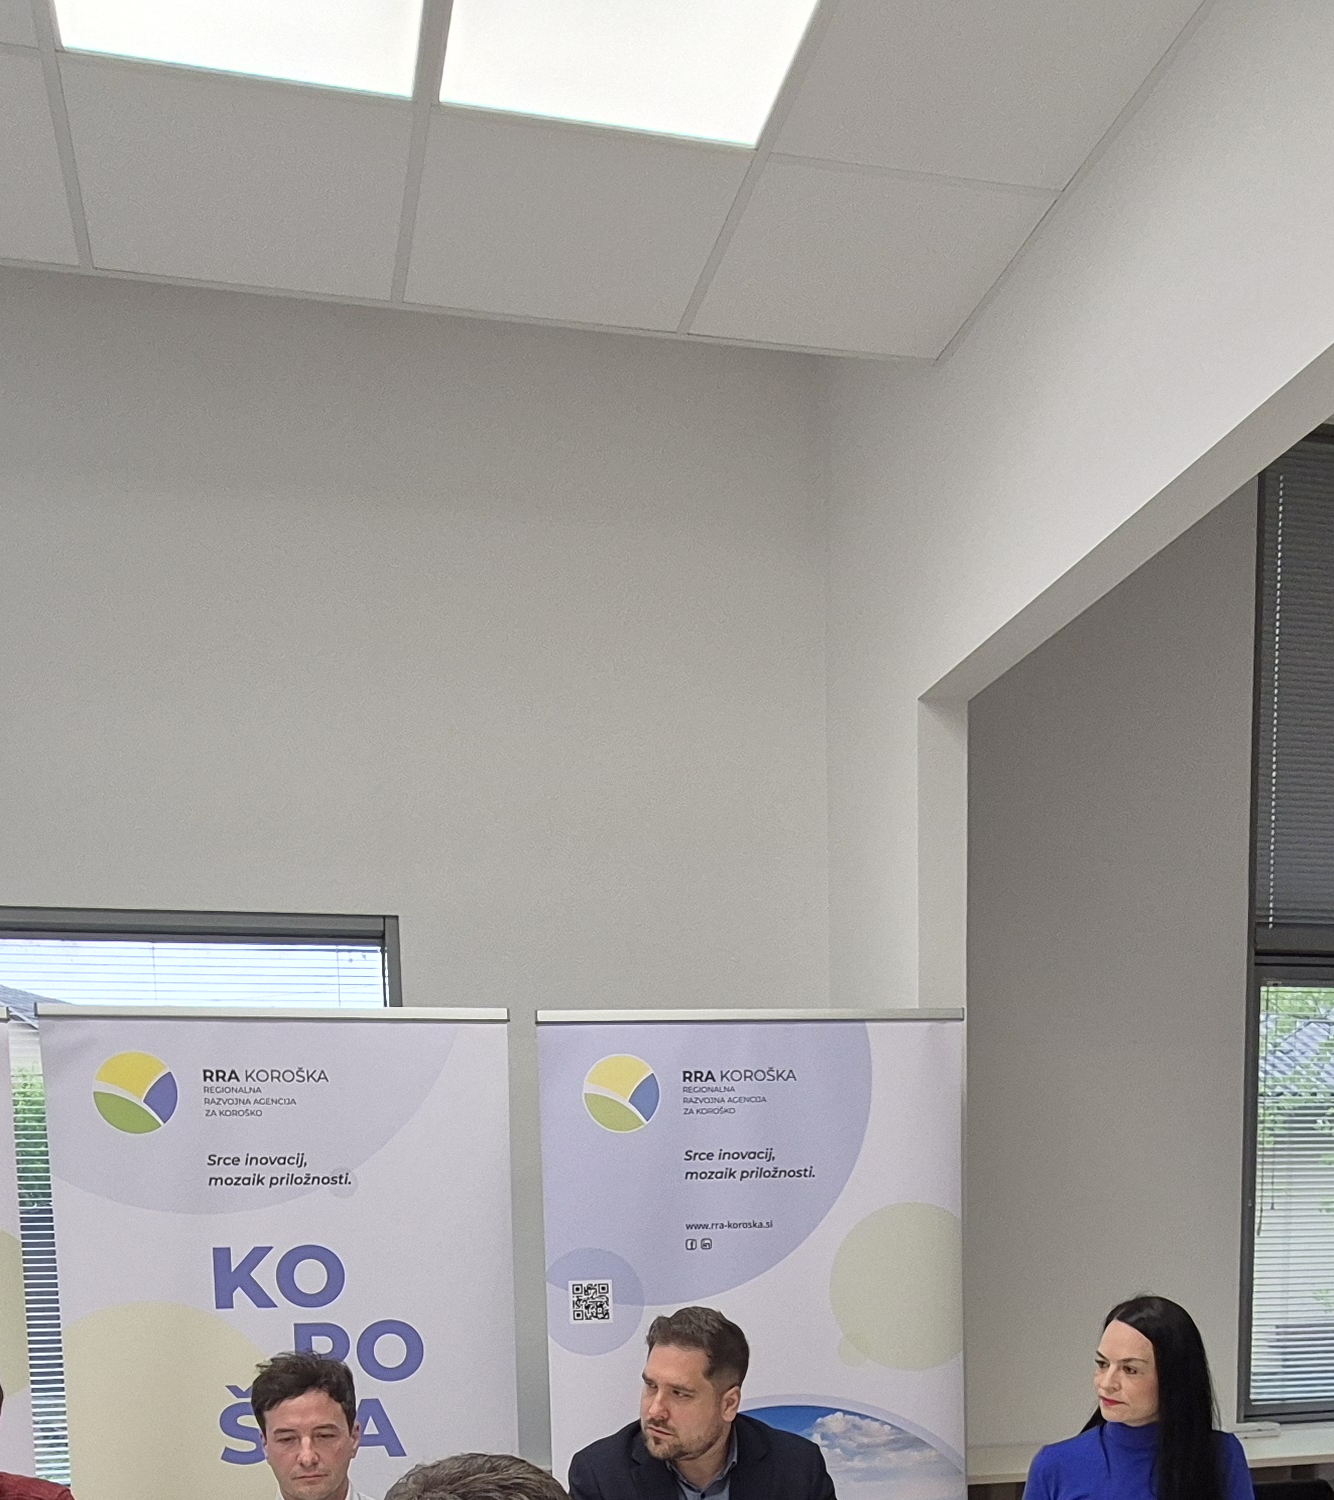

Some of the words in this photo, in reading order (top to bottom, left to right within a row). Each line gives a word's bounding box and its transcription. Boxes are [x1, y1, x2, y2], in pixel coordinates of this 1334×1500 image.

[202, 1069, 240, 1082] RRA
[245, 1067, 329, 1083] KOROŠKA
[682, 1070, 716, 1082] RRA
[720, 1067, 797, 1081] KOROŠKA
[203, 1086, 262, 1094] REGIONALNA
[205, 1109, 217, 1117] ZA
[219, 1108, 262, 1117] KOROŠKO
[207, 1154, 240, 1166] Srce
[245, 1153, 307, 1168] inovacij,
[684, 1150, 714, 1161] Srce
[718, 1148, 775, 1162] inovacij,
[208, 1173, 265, 1187] mozaik
[269, 1172, 352, 1188] priložnosti.
[685, 1167, 736, 1180] mozaik
[740, 1166, 815, 1181] priložnosti.
[685, 1220, 773, 1230] www.rra-koroska.si
[212, 1244, 346, 1310] KO
[219, 1384, 407, 1465] ŠA
